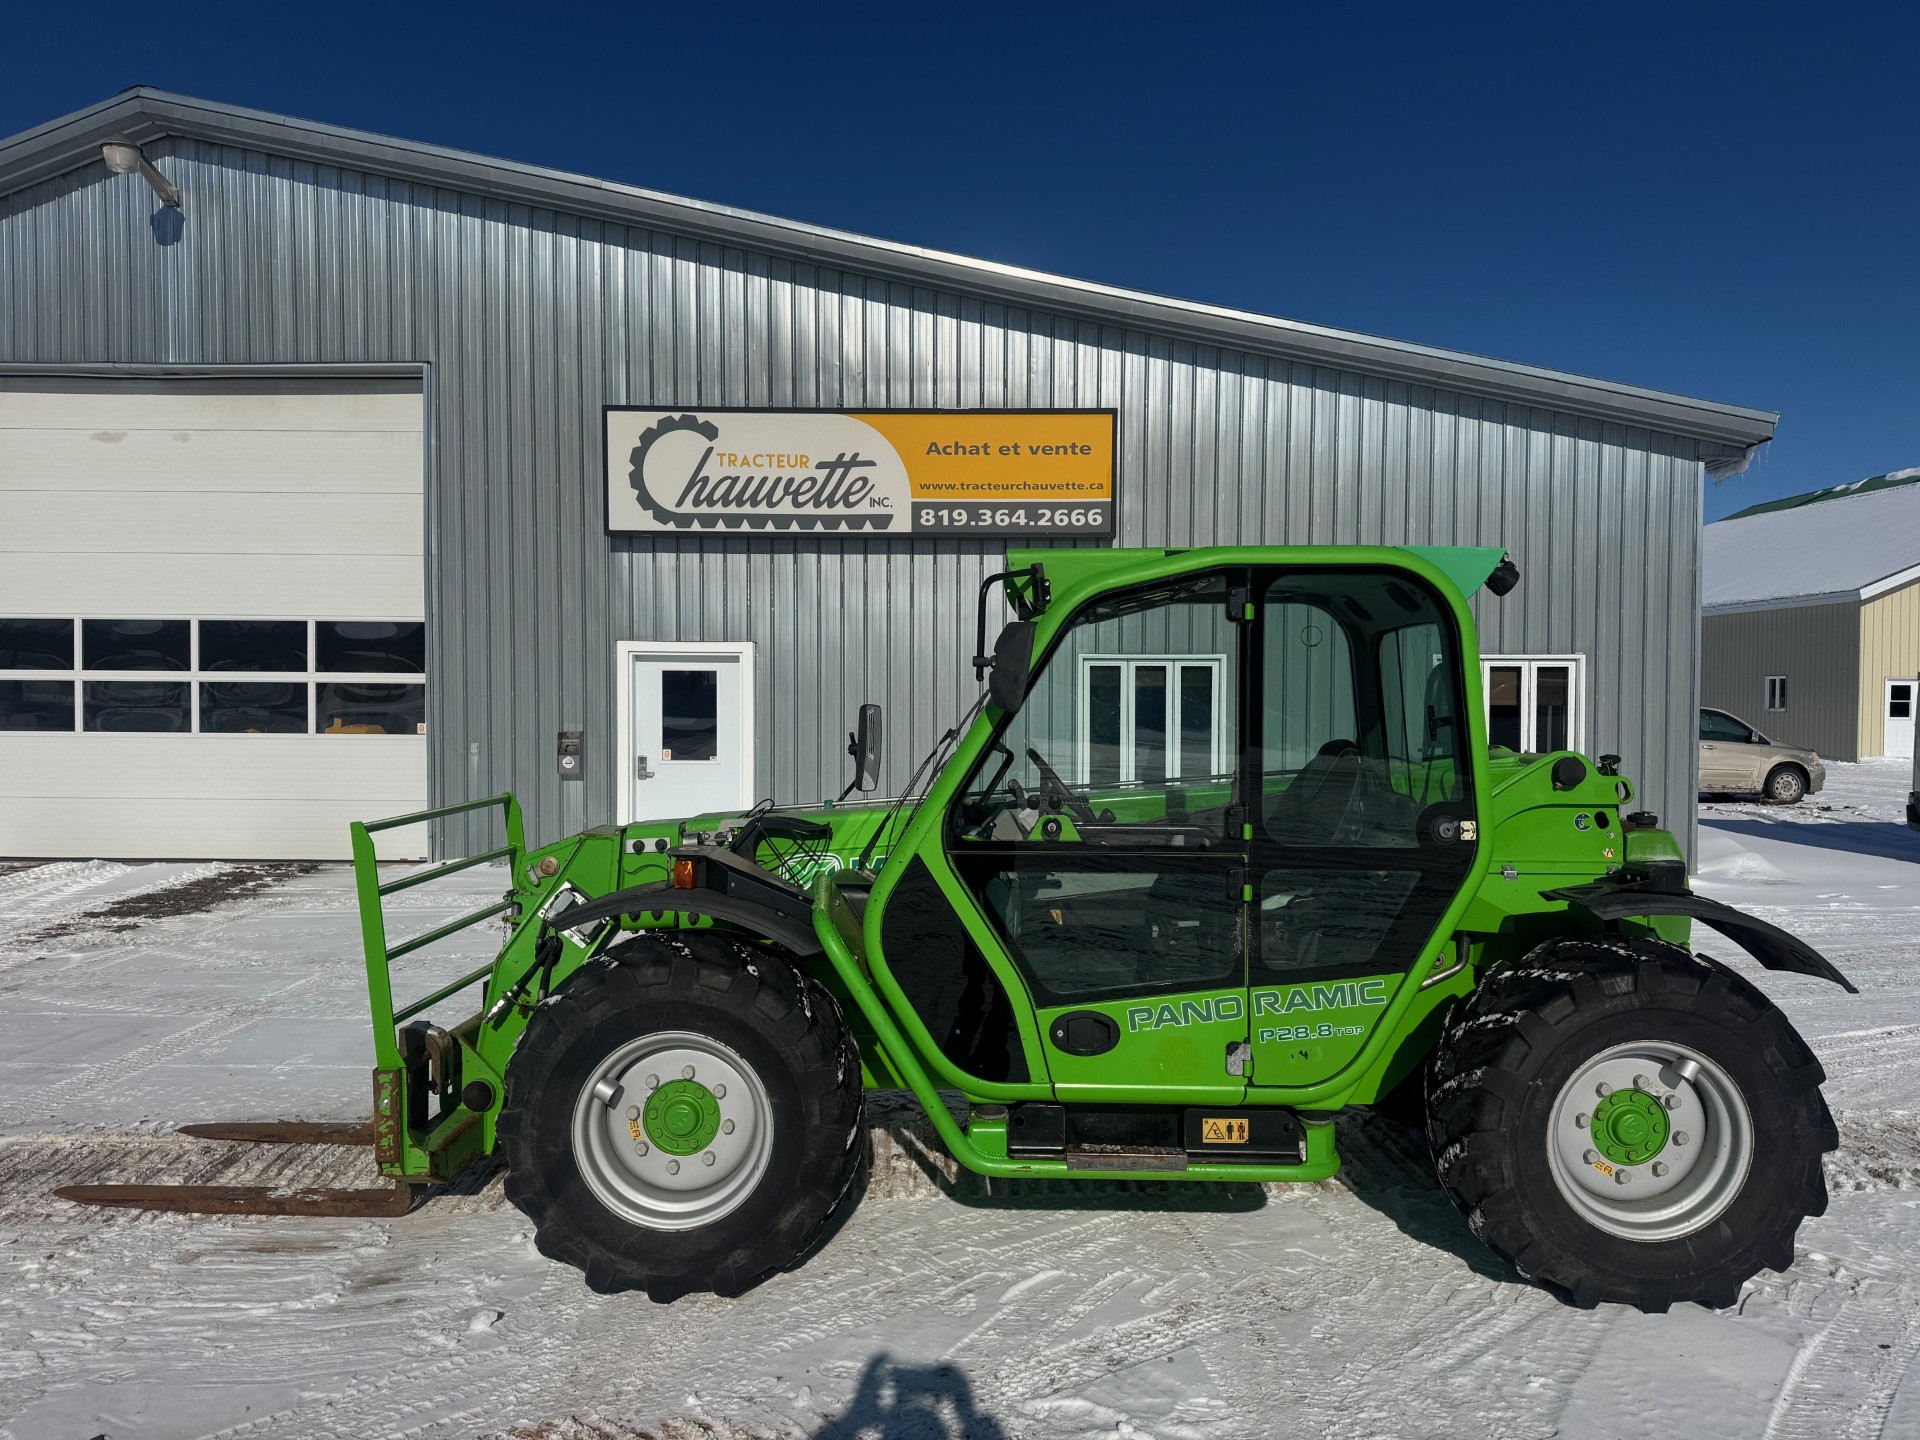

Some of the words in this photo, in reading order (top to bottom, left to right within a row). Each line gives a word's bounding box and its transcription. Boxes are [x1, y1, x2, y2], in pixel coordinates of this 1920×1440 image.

[926, 441, 991, 456] Achat
[998, 442, 1021, 456] et
[1028, 442, 1092, 456] vente
[716, 452, 810, 469] TRACTEUR
[629, 413, 880, 529] Chauvette
[869, 496, 894, 508] INC.
[919, 481, 1104, 491] www.tracteurchauvette.ca
[919, 508, 1103, 526] 819.364.2666
